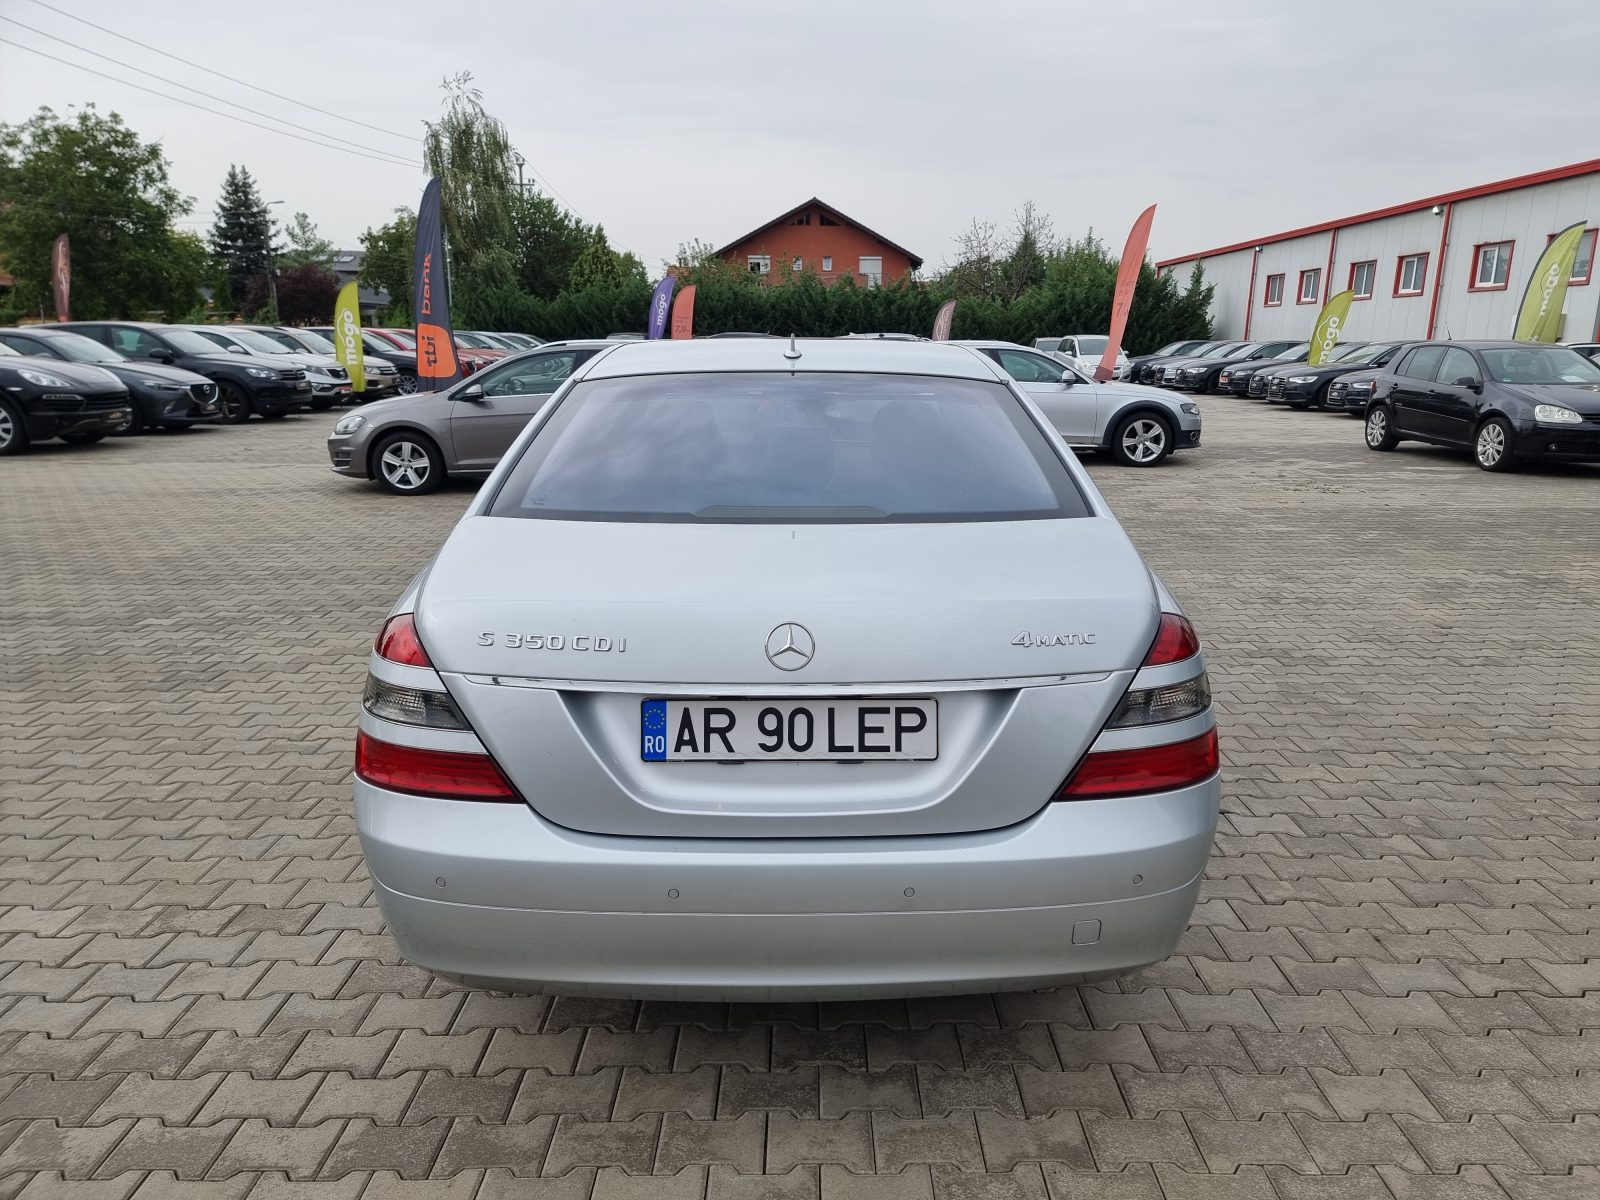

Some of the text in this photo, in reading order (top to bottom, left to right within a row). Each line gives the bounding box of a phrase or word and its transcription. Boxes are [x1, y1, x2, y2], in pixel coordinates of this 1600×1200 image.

[421, 252, 433, 315] bank
[657, 293, 668, 326] mogo
[343, 309, 361, 366] mogo
[1318, 315, 1339, 364] mogo
[477, 631, 628, 652] S 350 CDI
[1011, 631, 1097, 648] 4MATIC
[644, 735, 665, 753] RO
[673, 706, 928, 753] AR 90 LEP
